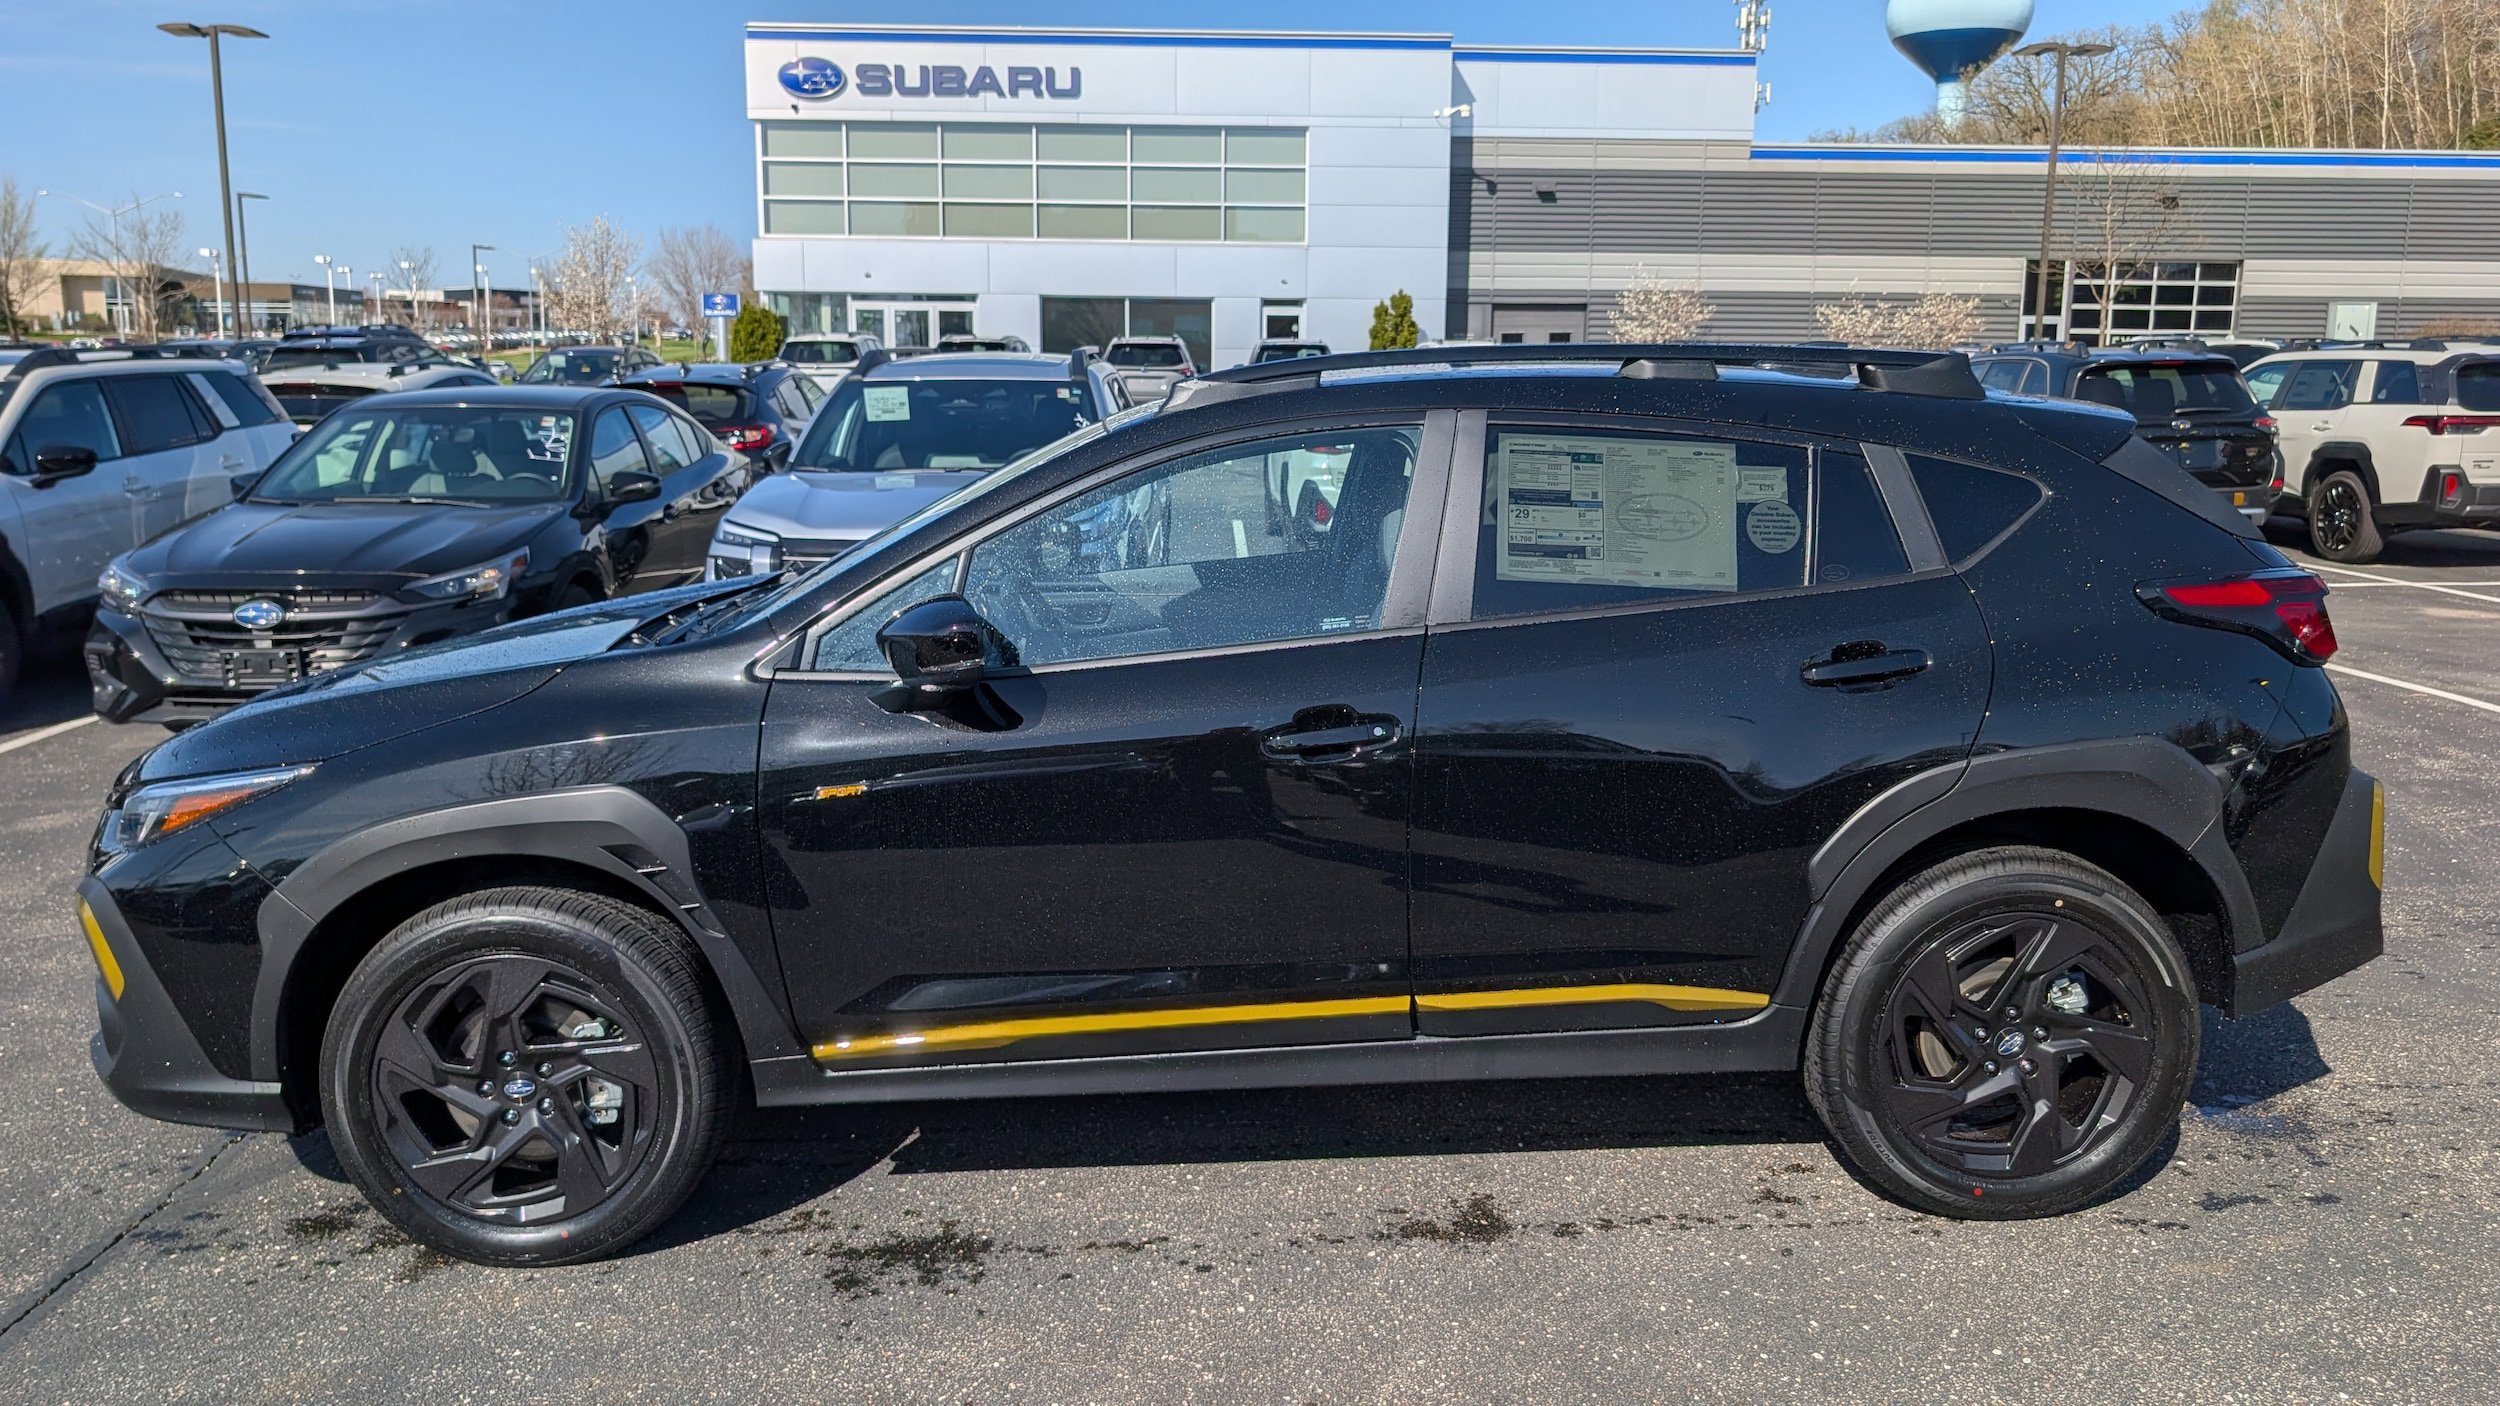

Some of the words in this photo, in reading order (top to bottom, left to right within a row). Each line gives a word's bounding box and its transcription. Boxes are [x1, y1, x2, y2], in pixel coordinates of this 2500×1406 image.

[855, 64, 1081, 99] SUBARU
[1514, 508, 1530, 519] 29
[817, 786, 864, 799] SPORT
[1866, 1129, 1895, 1165] OUTSIDE
